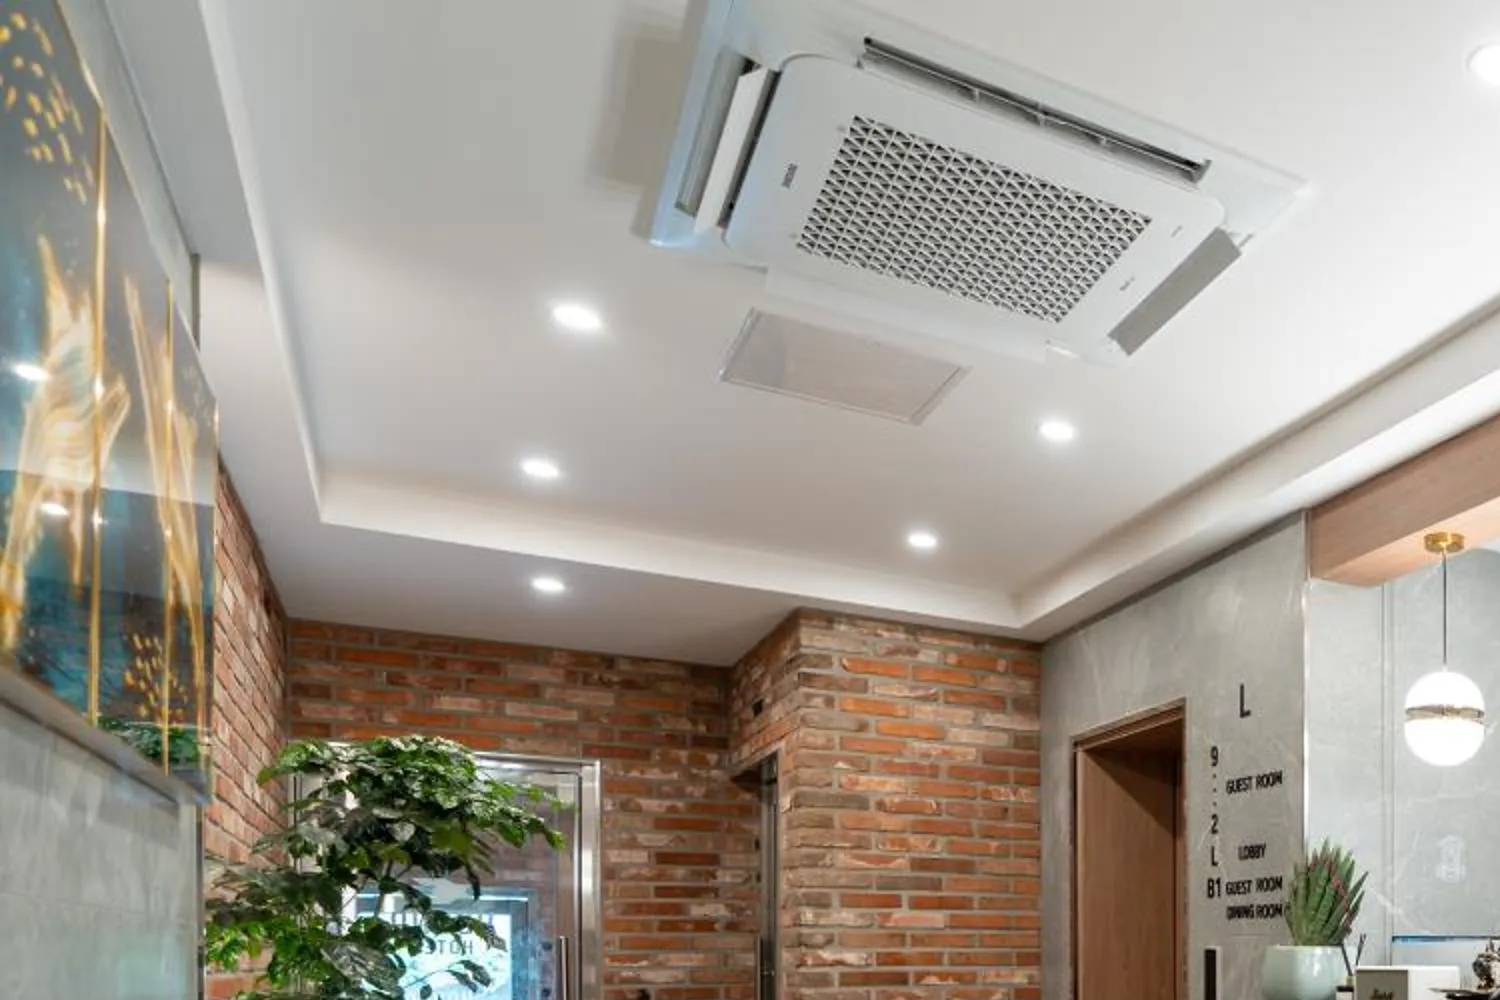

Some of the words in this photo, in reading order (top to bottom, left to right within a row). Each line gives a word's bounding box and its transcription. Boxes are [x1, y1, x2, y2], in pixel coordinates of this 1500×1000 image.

[1239, 683, 1252, 718] L
[1210, 746, 1219, 767] 9
[1225, 775, 1253, 795] GUEST
[1256, 769, 1283, 790] ROOM
[1210, 813, 1219, 834] 2
[1210, 845, 1219, 867] L
[1238, 843, 1267, 861] LOBBY
[1207, 877, 1221, 898] B1
[1226, 879, 1253, 895] GUEST
[1256, 876, 1283, 892] ROOM
[1226, 904, 1254, 920] DINING
[1256, 903, 1283, 919] ROOM
